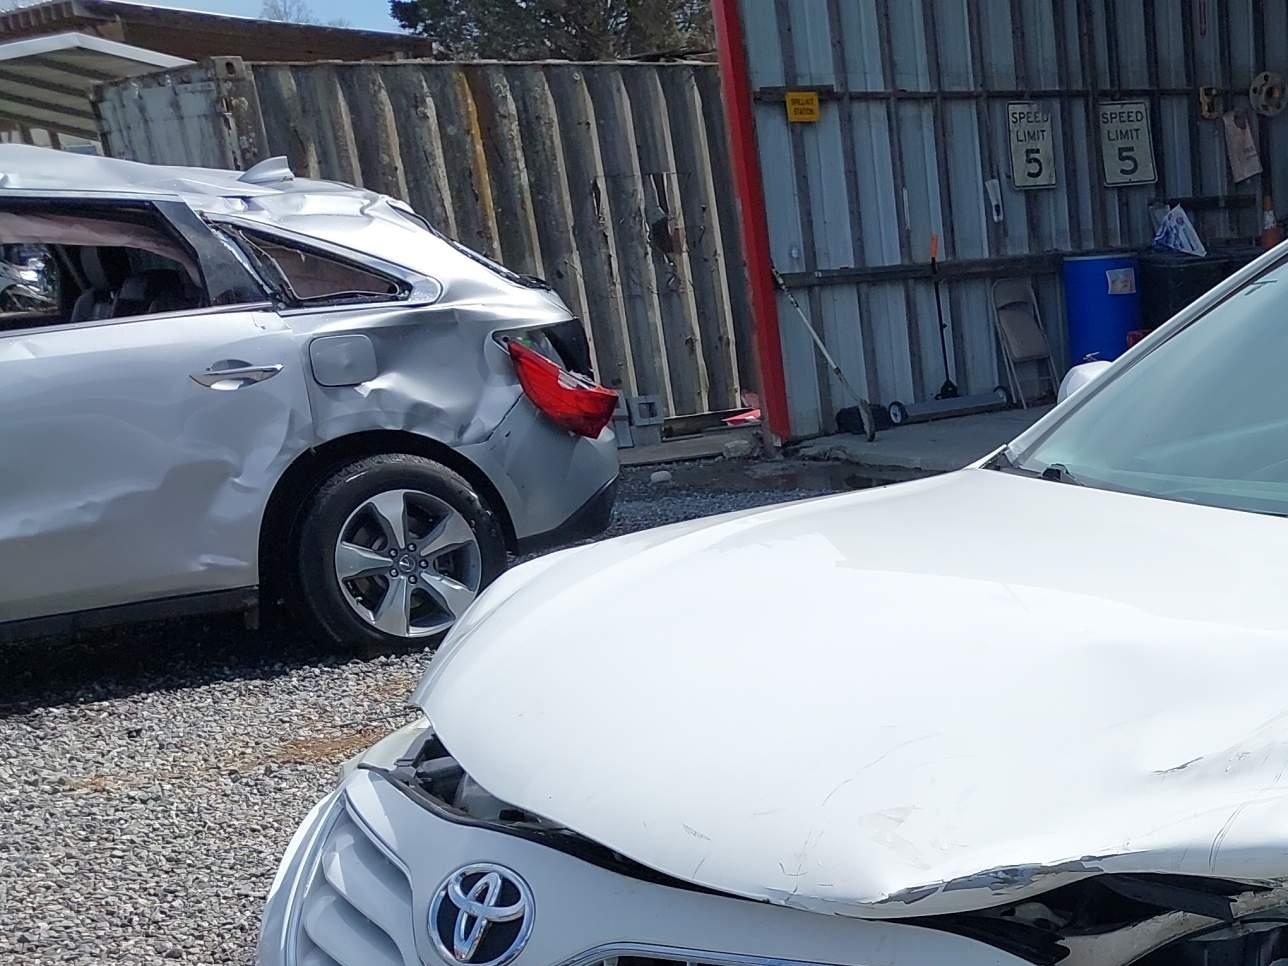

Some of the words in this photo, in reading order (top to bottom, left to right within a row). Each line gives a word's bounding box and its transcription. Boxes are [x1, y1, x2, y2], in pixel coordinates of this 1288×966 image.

[1102, 110, 1144, 124] SPEED
[1016, 129, 1046, 142] LIMIT
[1107, 128, 1140, 141] LIMIT
[1025, 148, 1043, 178] 5
[1117, 146, 1138, 175] 5
